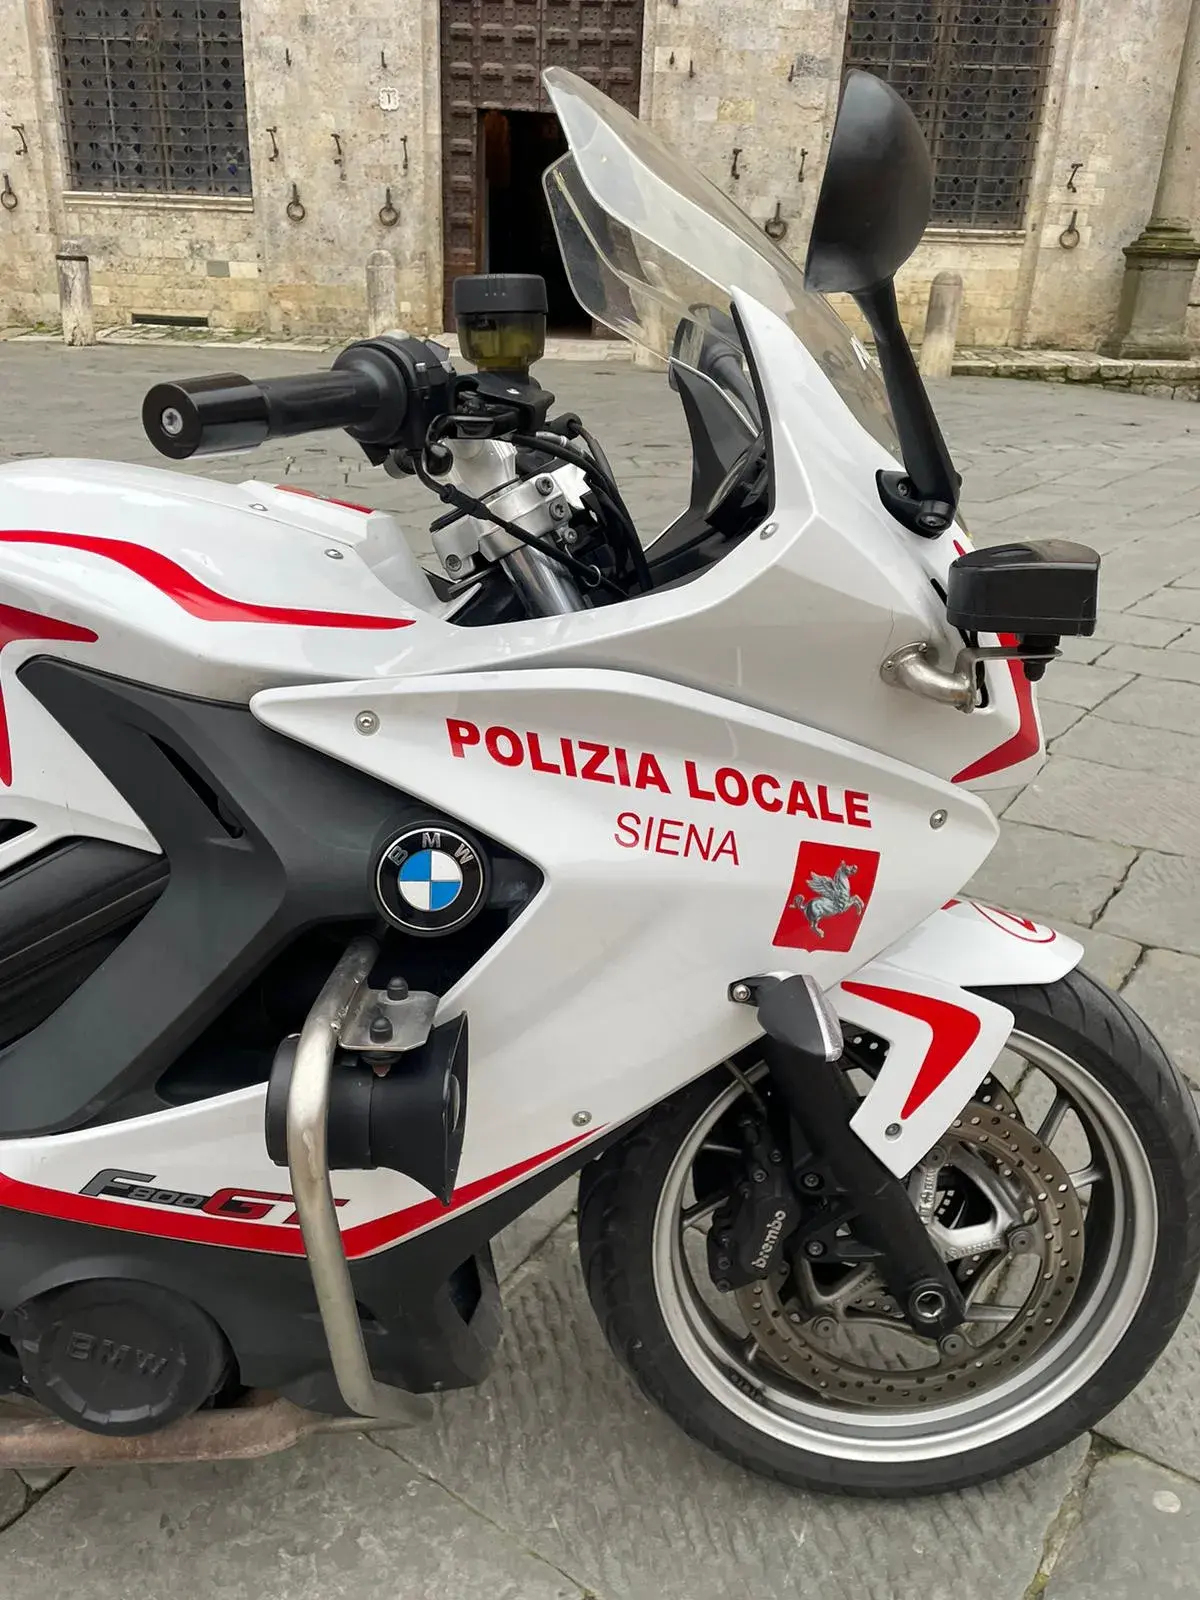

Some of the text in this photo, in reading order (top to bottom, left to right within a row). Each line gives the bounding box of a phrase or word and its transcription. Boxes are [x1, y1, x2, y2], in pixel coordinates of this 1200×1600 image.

[446, 718, 872, 828] POLIZIA LOCALE
[387, 832, 474, 866] BMW
[614, 812, 739, 866] SIENA
[751, 1210, 786, 1269] brembo
[66, 1331, 168, 1377] BMW
